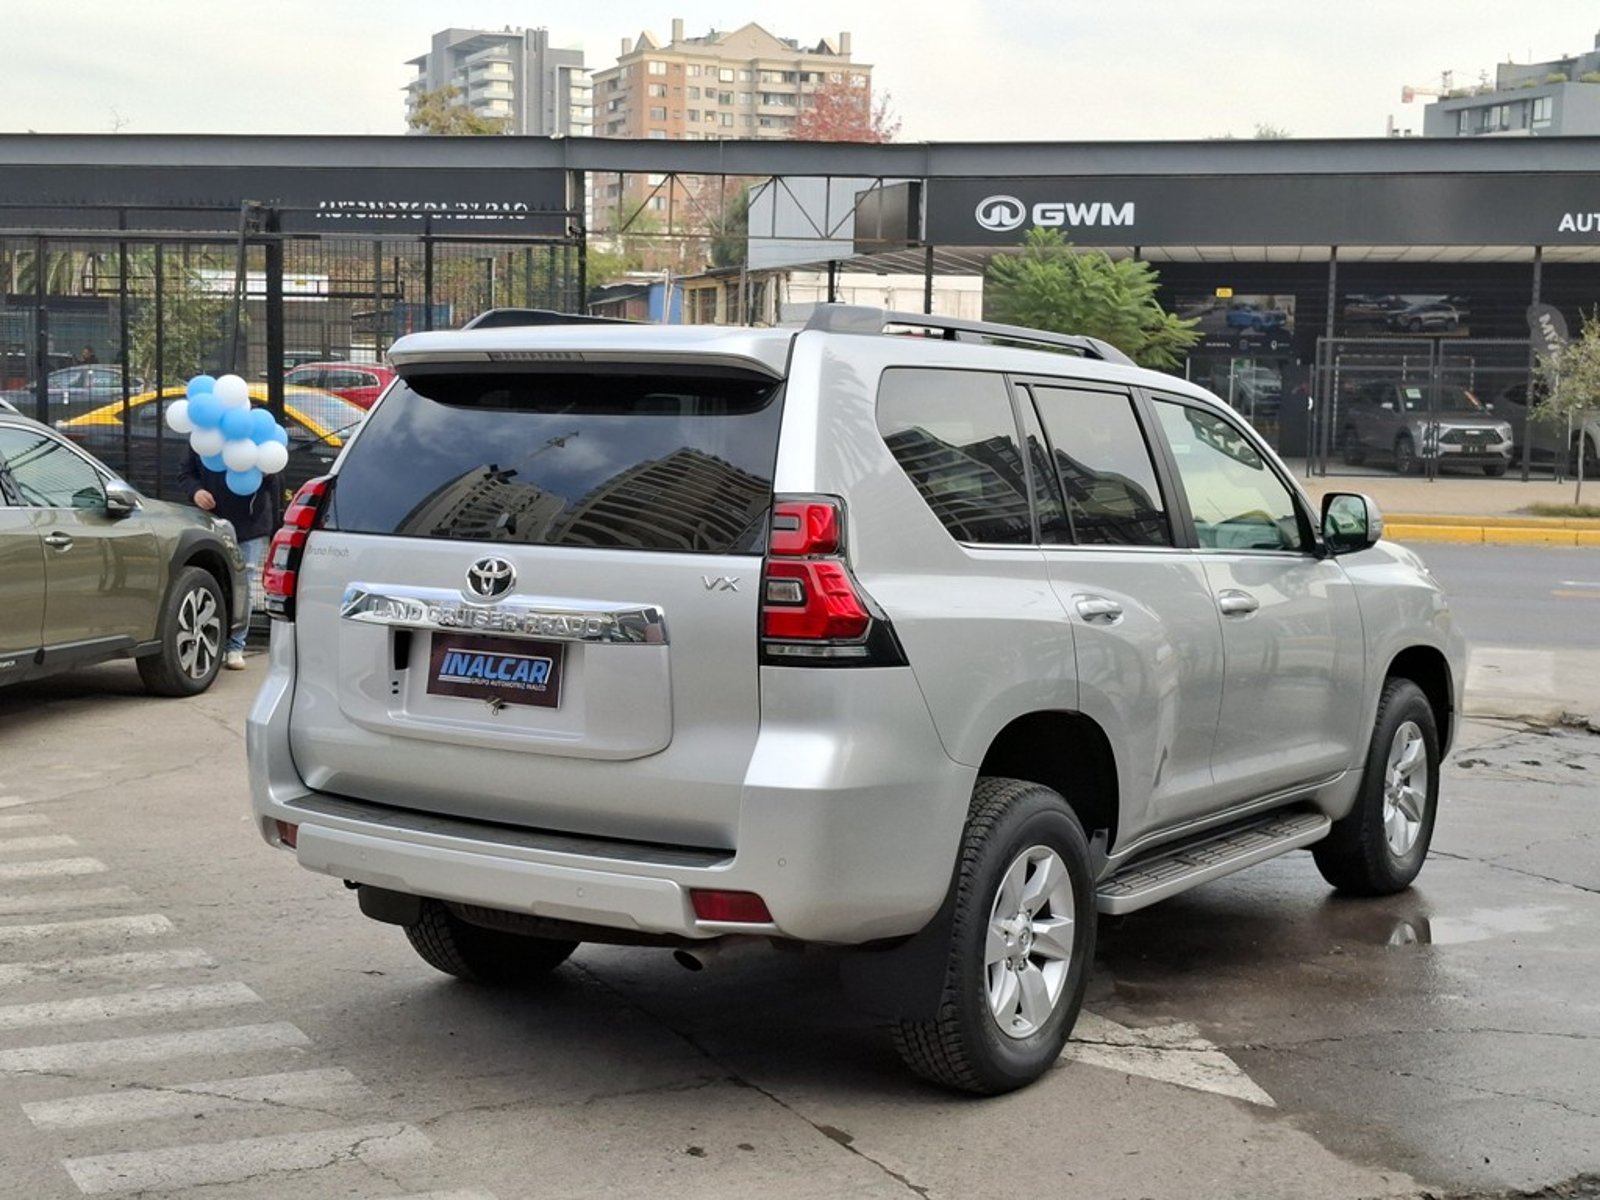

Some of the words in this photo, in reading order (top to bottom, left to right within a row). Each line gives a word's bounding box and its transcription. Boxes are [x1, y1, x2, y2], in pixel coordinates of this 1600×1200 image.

[1032, 202, 1134, 226] GWM
[700, 575, 741, 592] VX
[372, 600, 423, 621] LAND
[427, 606, 517, 631] CRUISER
[523, 613, 603, 636] PRADO
[440, 653, 547, 683] INALCAR
